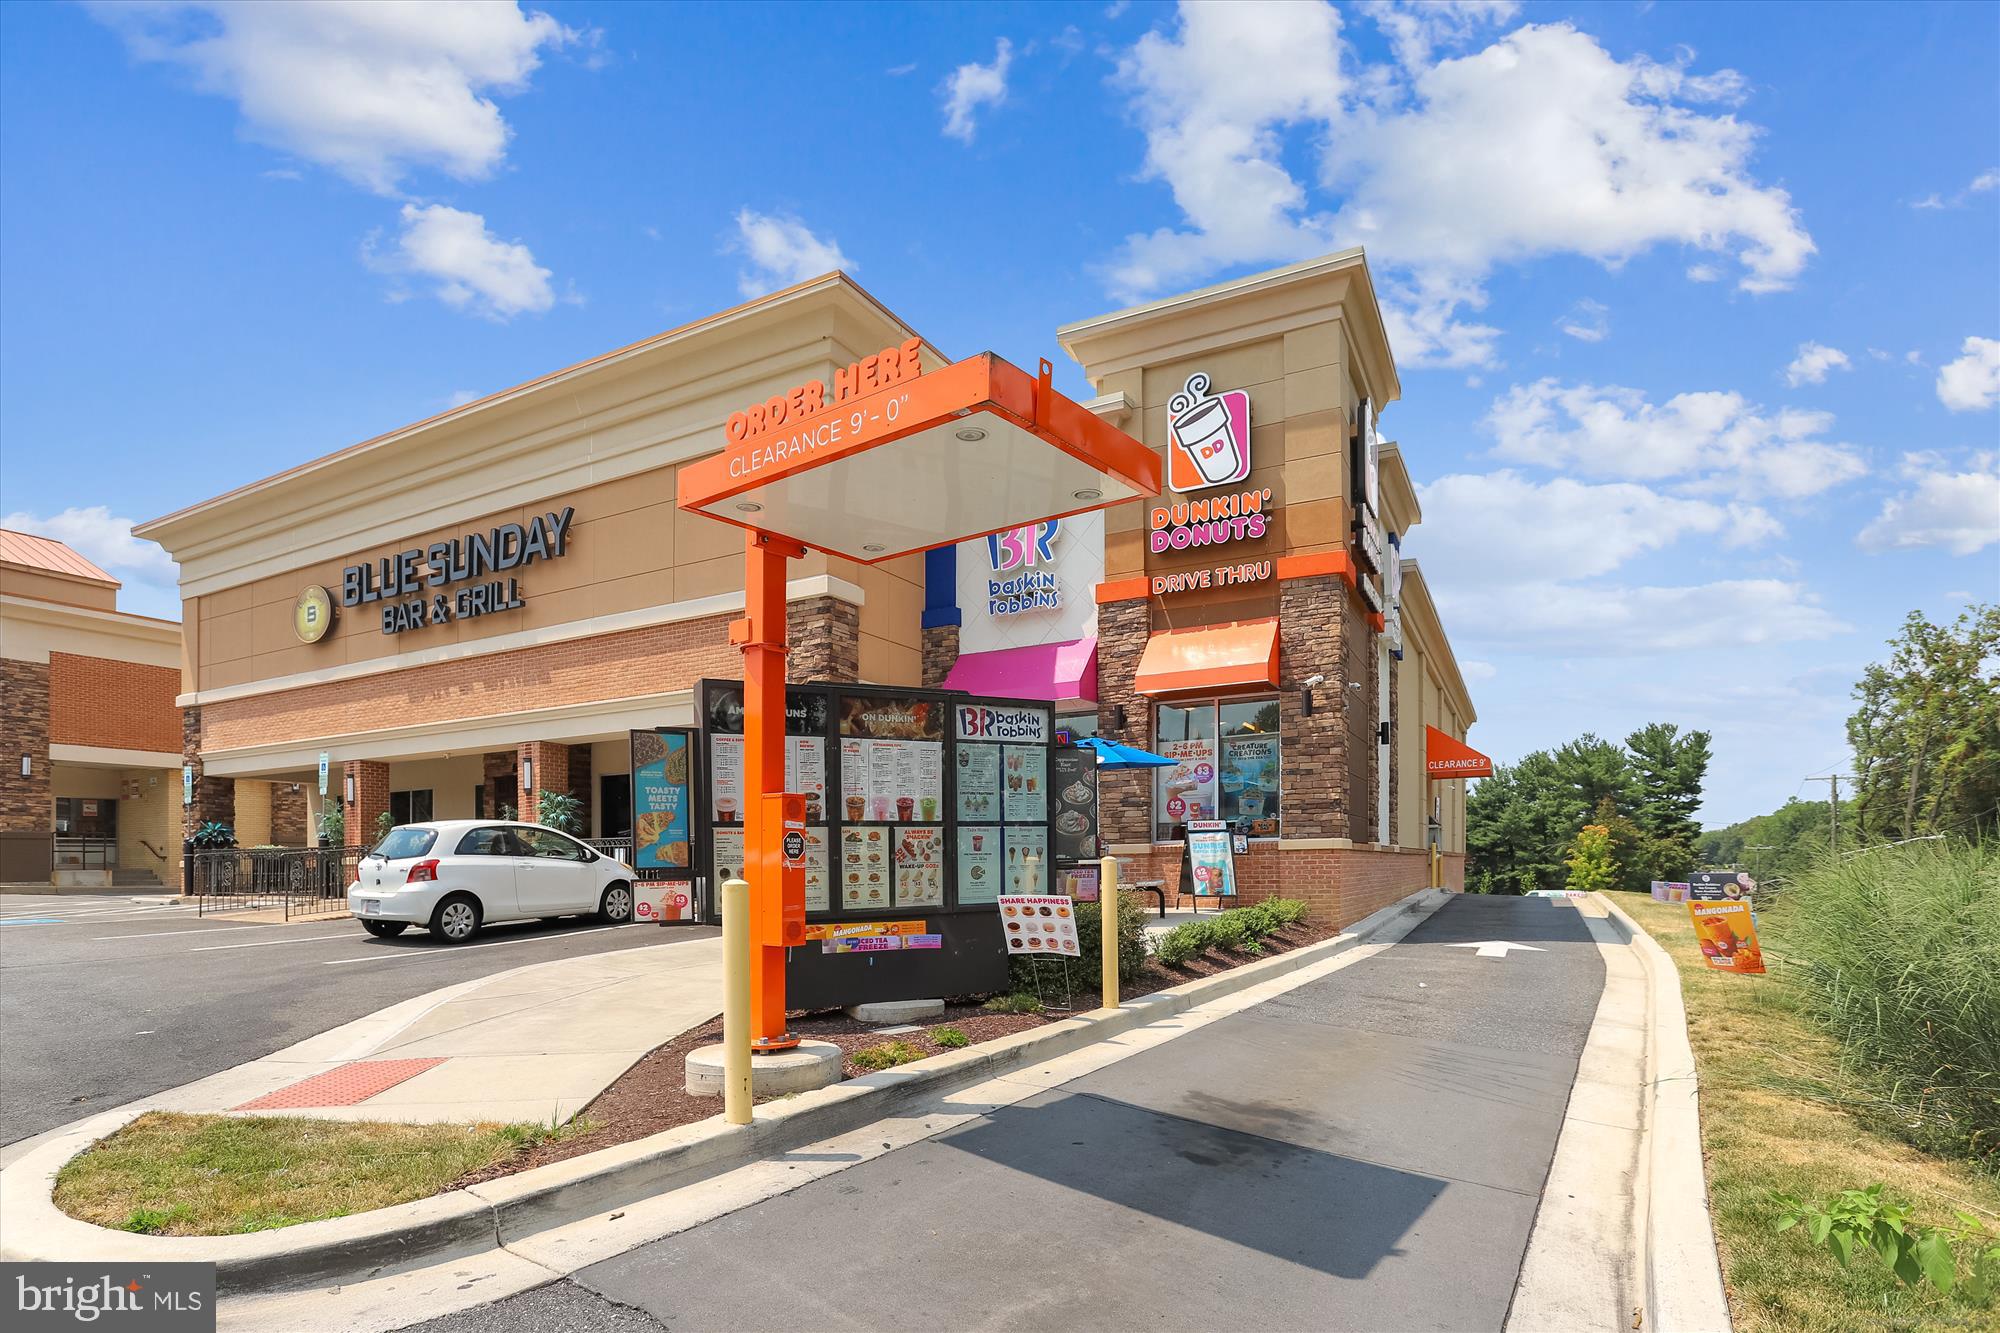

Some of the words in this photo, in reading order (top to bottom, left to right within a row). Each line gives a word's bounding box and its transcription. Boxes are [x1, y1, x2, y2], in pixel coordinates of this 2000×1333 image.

[725, 380, 825, 444] ORDER
[833, 336, 922, 400] HERE
[729, 419, 842, 478] CLEARANCE
[1200, 439, 1225, 459] DD
[1151, 488, 1272, 530] DUNKIN'
[1151, 514, 1266, 553] DONUTS
[343, 549, 423, 608] BLUE
[427, 506, 575, 587] SUNDAY
[988, 571, 1056, 597] baskin
[1152, 570, 1211, 595] DRIVE
[1215, 560, 1271, 586] THRU
[382, 599, 426, 635] BAR
[431, 594, 450, 625] &
[455, 577, 525, 620] GRILL
[988, 591, 1058, 615] robbins
[786, 708, 807, 718] UNS
[862, 713, 876, 721] ON
[879, 714, 918, 723] DUNKIN'
[960, 707, 996, 737] BR
[995, 711, 1040, 726] baskin
[996, 725, 1042, 739] robbins
[1229, 748, 1272, 757] CREATIONS
[1232, 742, 1268, 750] CREATURE
[1428, 759, 1477, 769] CLEARANCE
[645, 787, 681, 795] TOASTY
[649, 802, 677, 810] TASTY
[1169, 800, 1182, 810] $2
[1694, 905, 1744, 916] MANGONADA
[832, 924, 872, 937] MANGONADA
